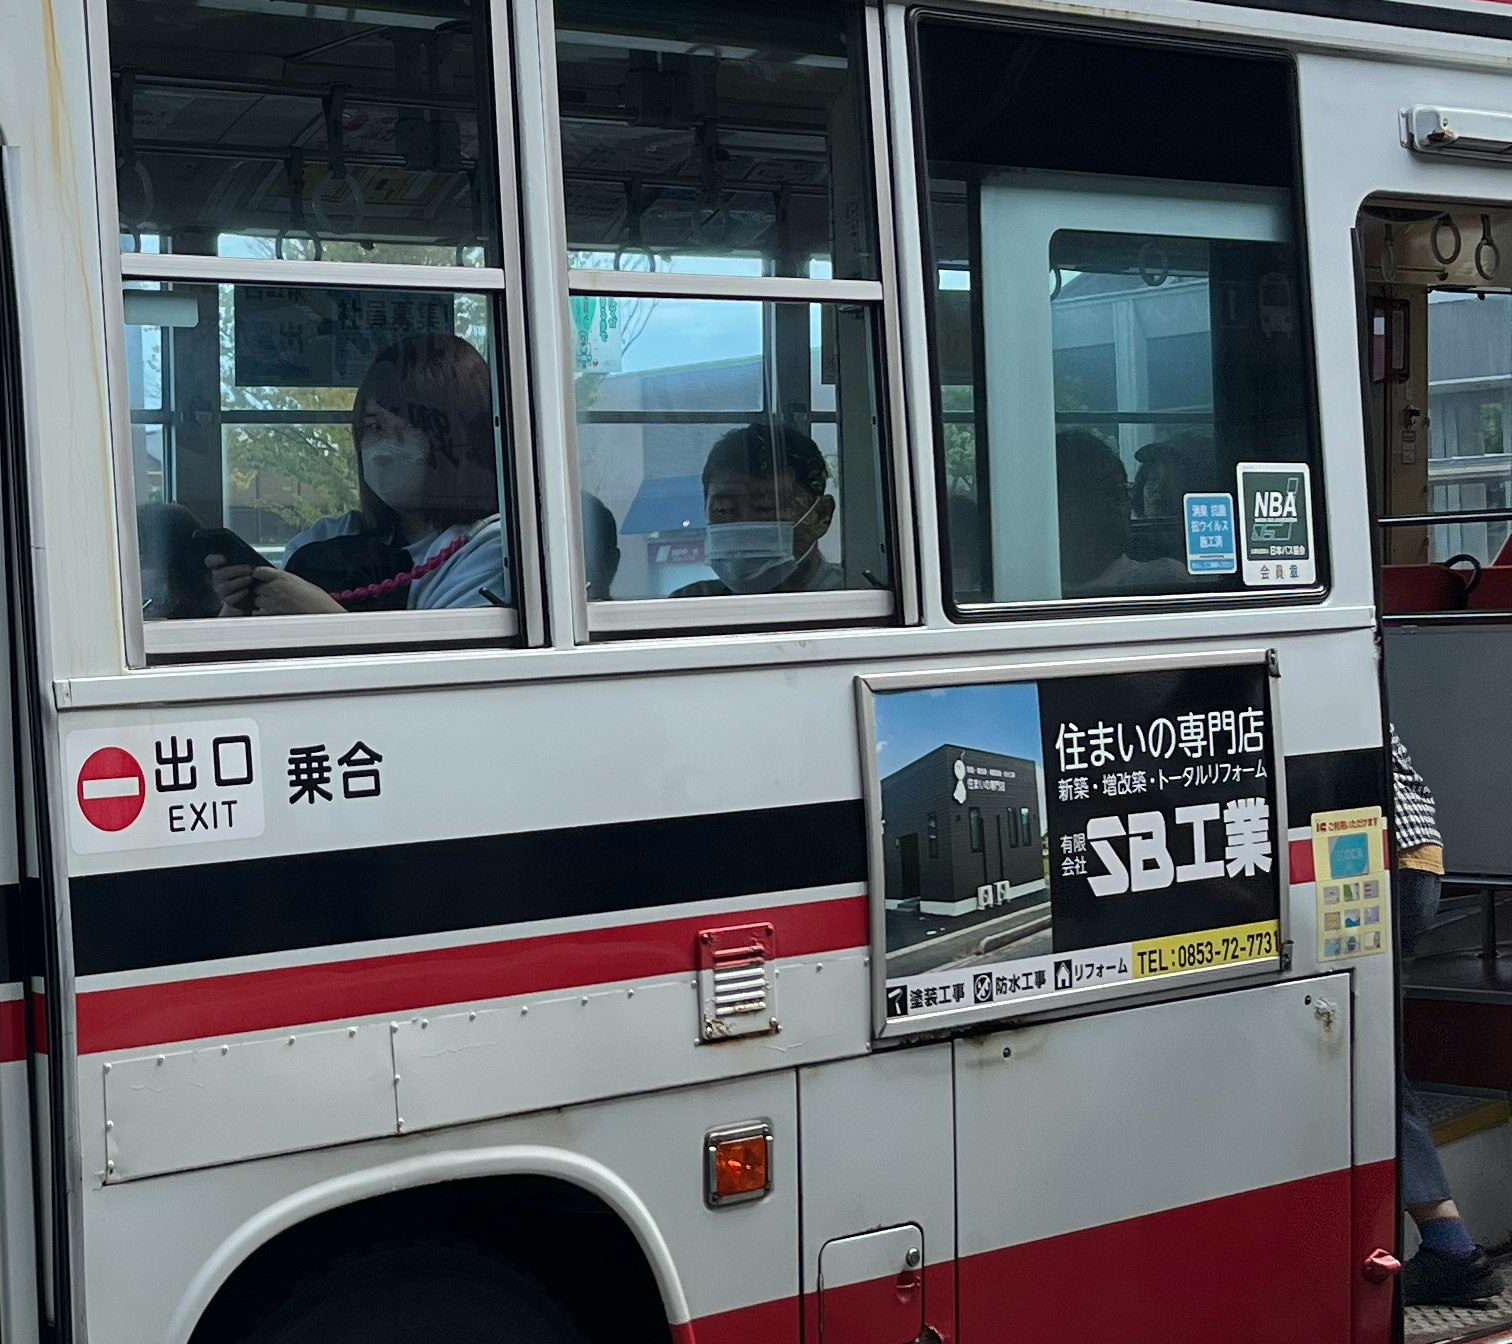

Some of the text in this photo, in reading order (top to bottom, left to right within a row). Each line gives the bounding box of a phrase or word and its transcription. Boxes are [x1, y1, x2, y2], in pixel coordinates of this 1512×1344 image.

[1254, 491, 1297, 518] NBA
[1055, 707, 1265, 772] 住まいの専門店
[155, 736, 253, 793] 出口
[287, 741, 383, 804] 乗合
[1058, 759, 1268, 802] 新築・増改築・トータルリフォーム
[169, 800, 237, 832] EXIT
[1060, 832, 1086, 854] 有限
[1061, 856, 1087, 877] 会社
[910, 958, 1128, 1009] 塗装工事 防水工事 リフォーム
